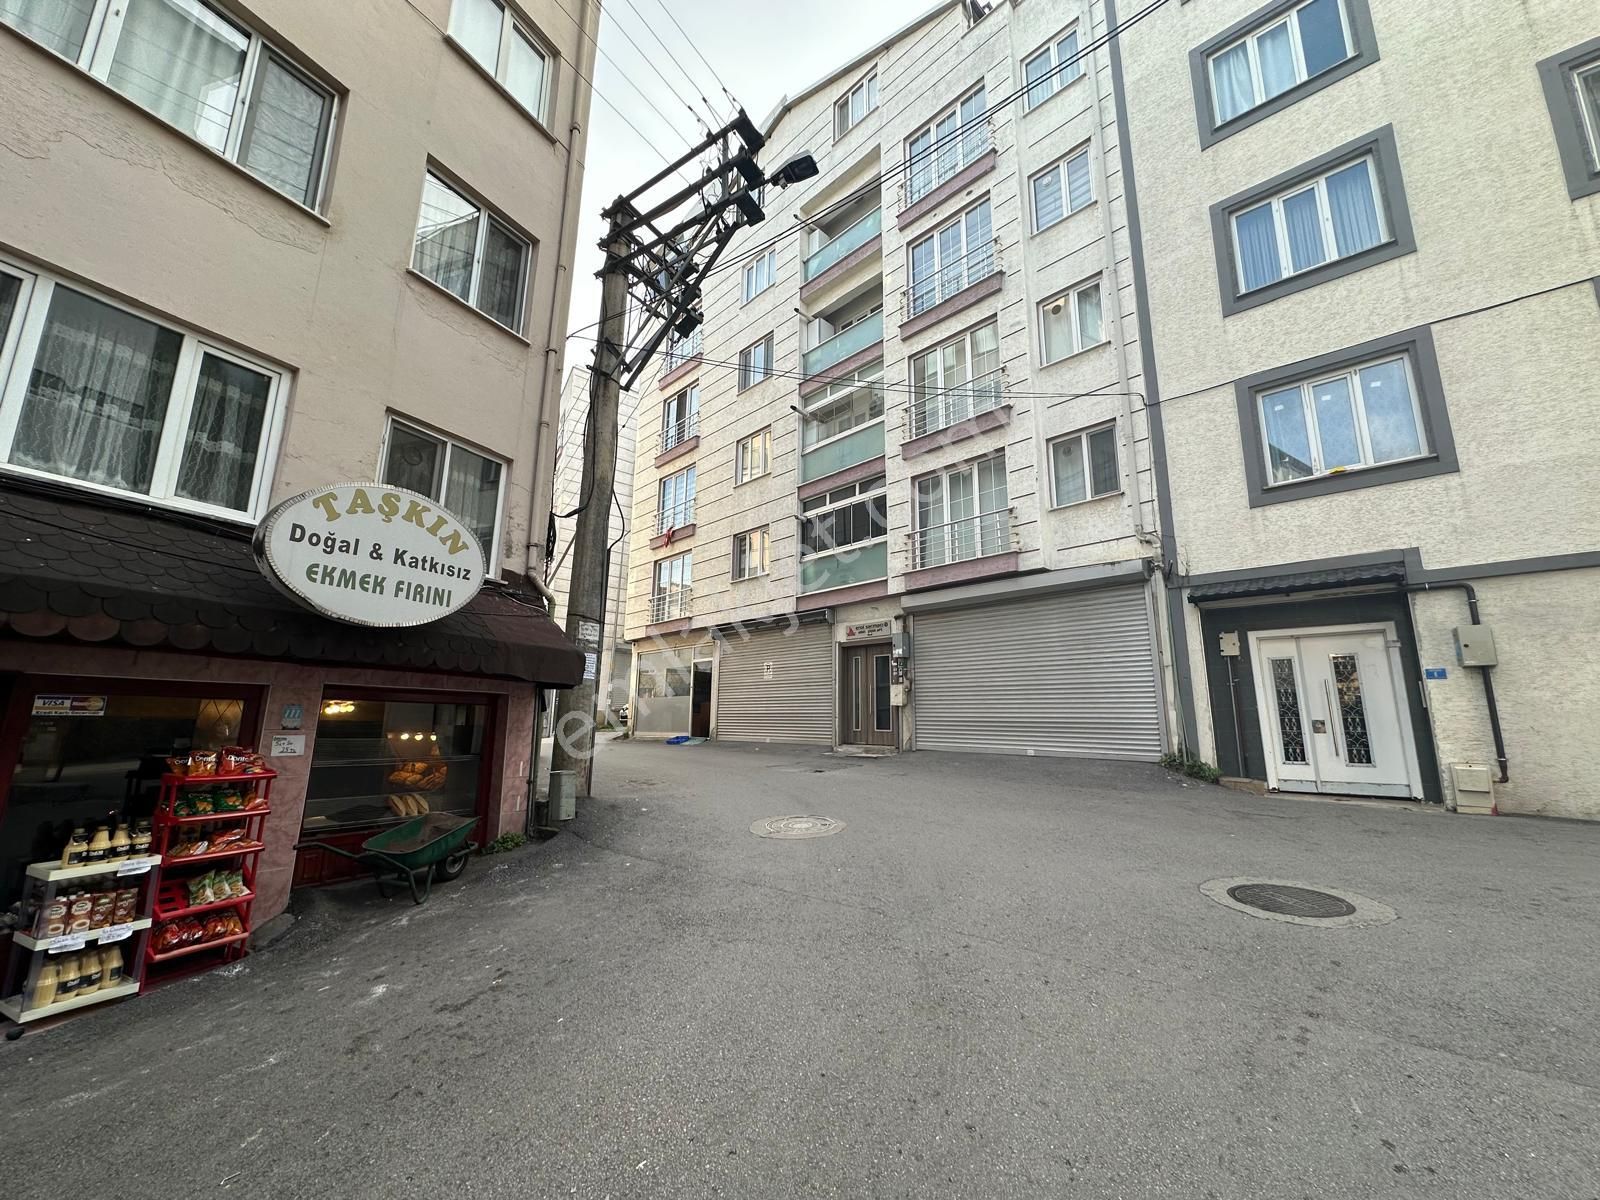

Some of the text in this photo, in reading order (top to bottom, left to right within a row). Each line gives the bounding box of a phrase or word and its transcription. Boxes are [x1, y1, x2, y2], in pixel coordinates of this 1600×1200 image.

[289, 522, 472, 581] Doğal & Katkısız
[312, 488, 469, 556] TAŞKIN
[306, 563, 452, 608] EKMEK FIRINI
